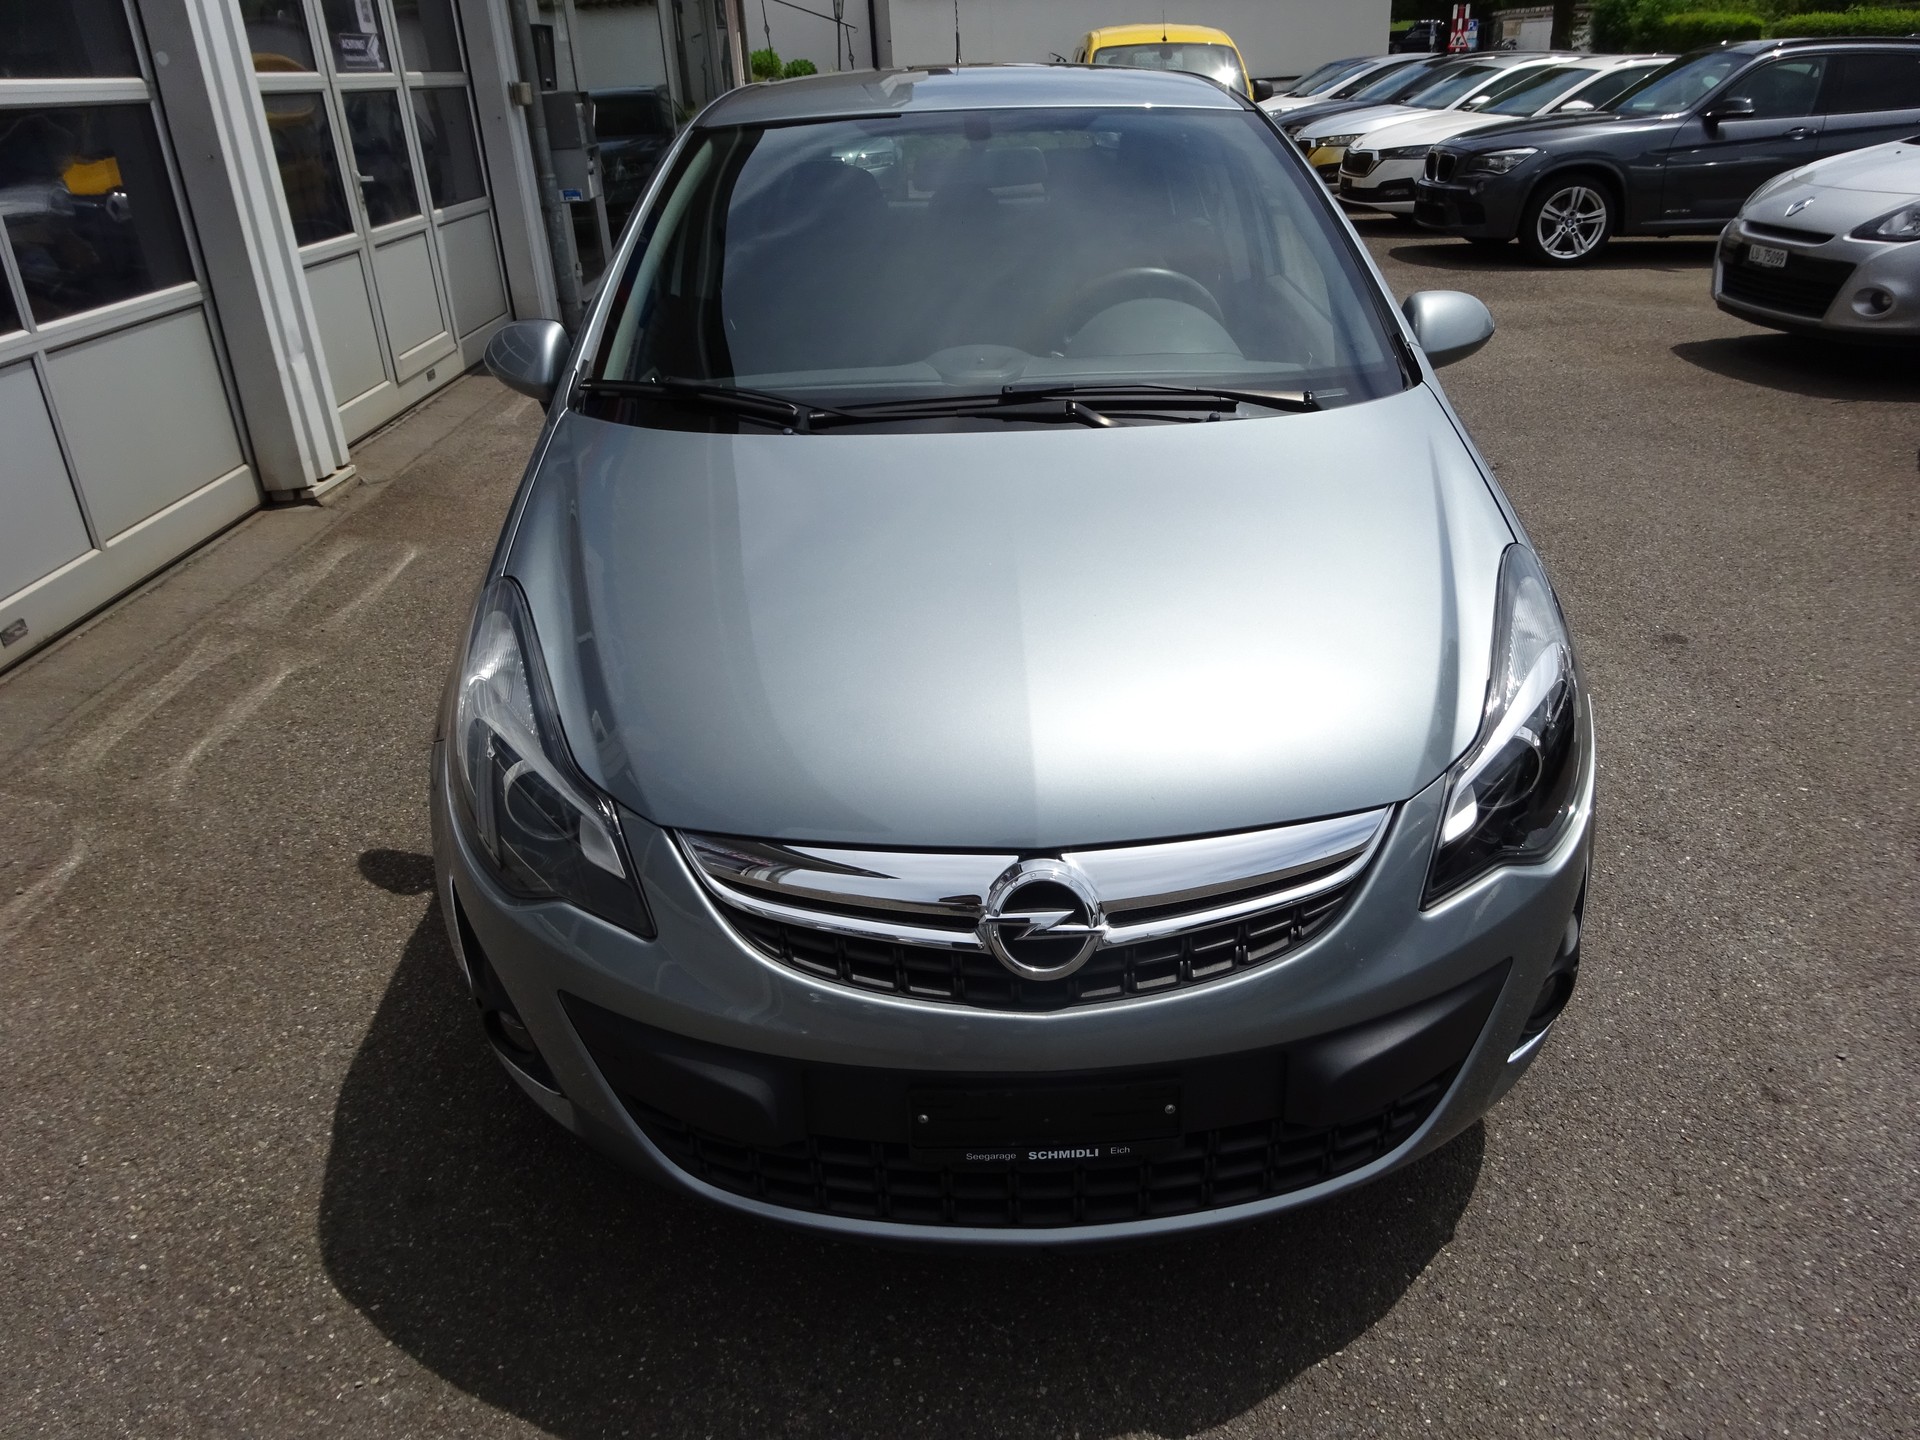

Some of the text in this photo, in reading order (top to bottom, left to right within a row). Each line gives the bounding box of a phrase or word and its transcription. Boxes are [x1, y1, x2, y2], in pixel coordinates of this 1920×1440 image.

[966, 1147, 1131, 1162] Seegarage SCHMIDLI Eich
